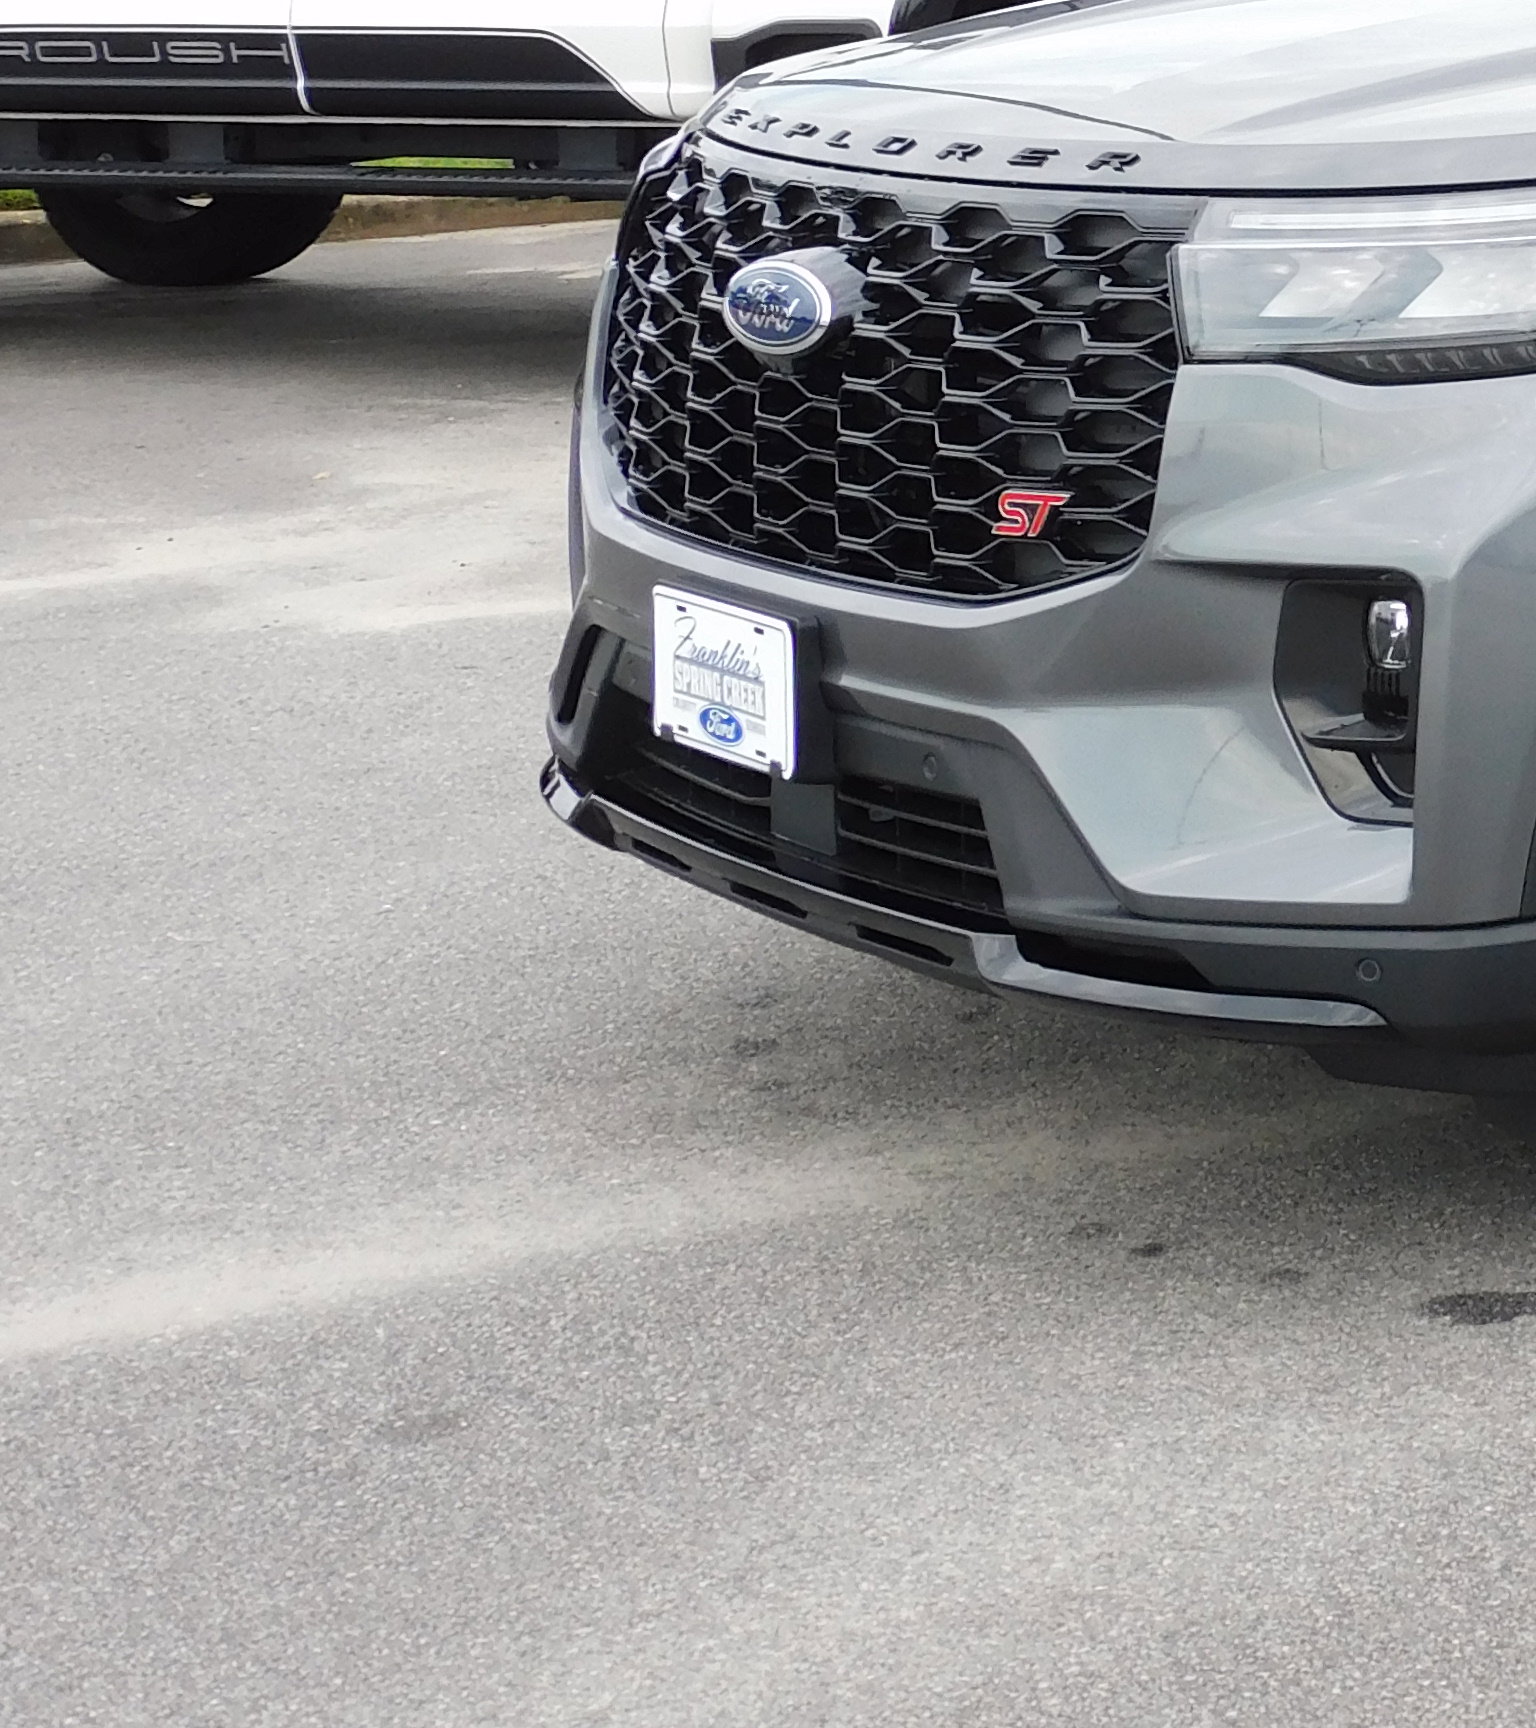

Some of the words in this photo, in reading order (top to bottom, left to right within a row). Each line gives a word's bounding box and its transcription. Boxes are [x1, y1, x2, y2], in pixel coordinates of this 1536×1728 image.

[721, 108, 1142, 172] EXPLORER
[738, 278, 801, 333] Ford
[991, 488, 1072, 537] ST
[674, 616, 764, 680] Franklin's
[675, 661, 722, 703] SPRING
[723, 674, 765, 717] CREEK
[706, 709, 737, 740] Ford
